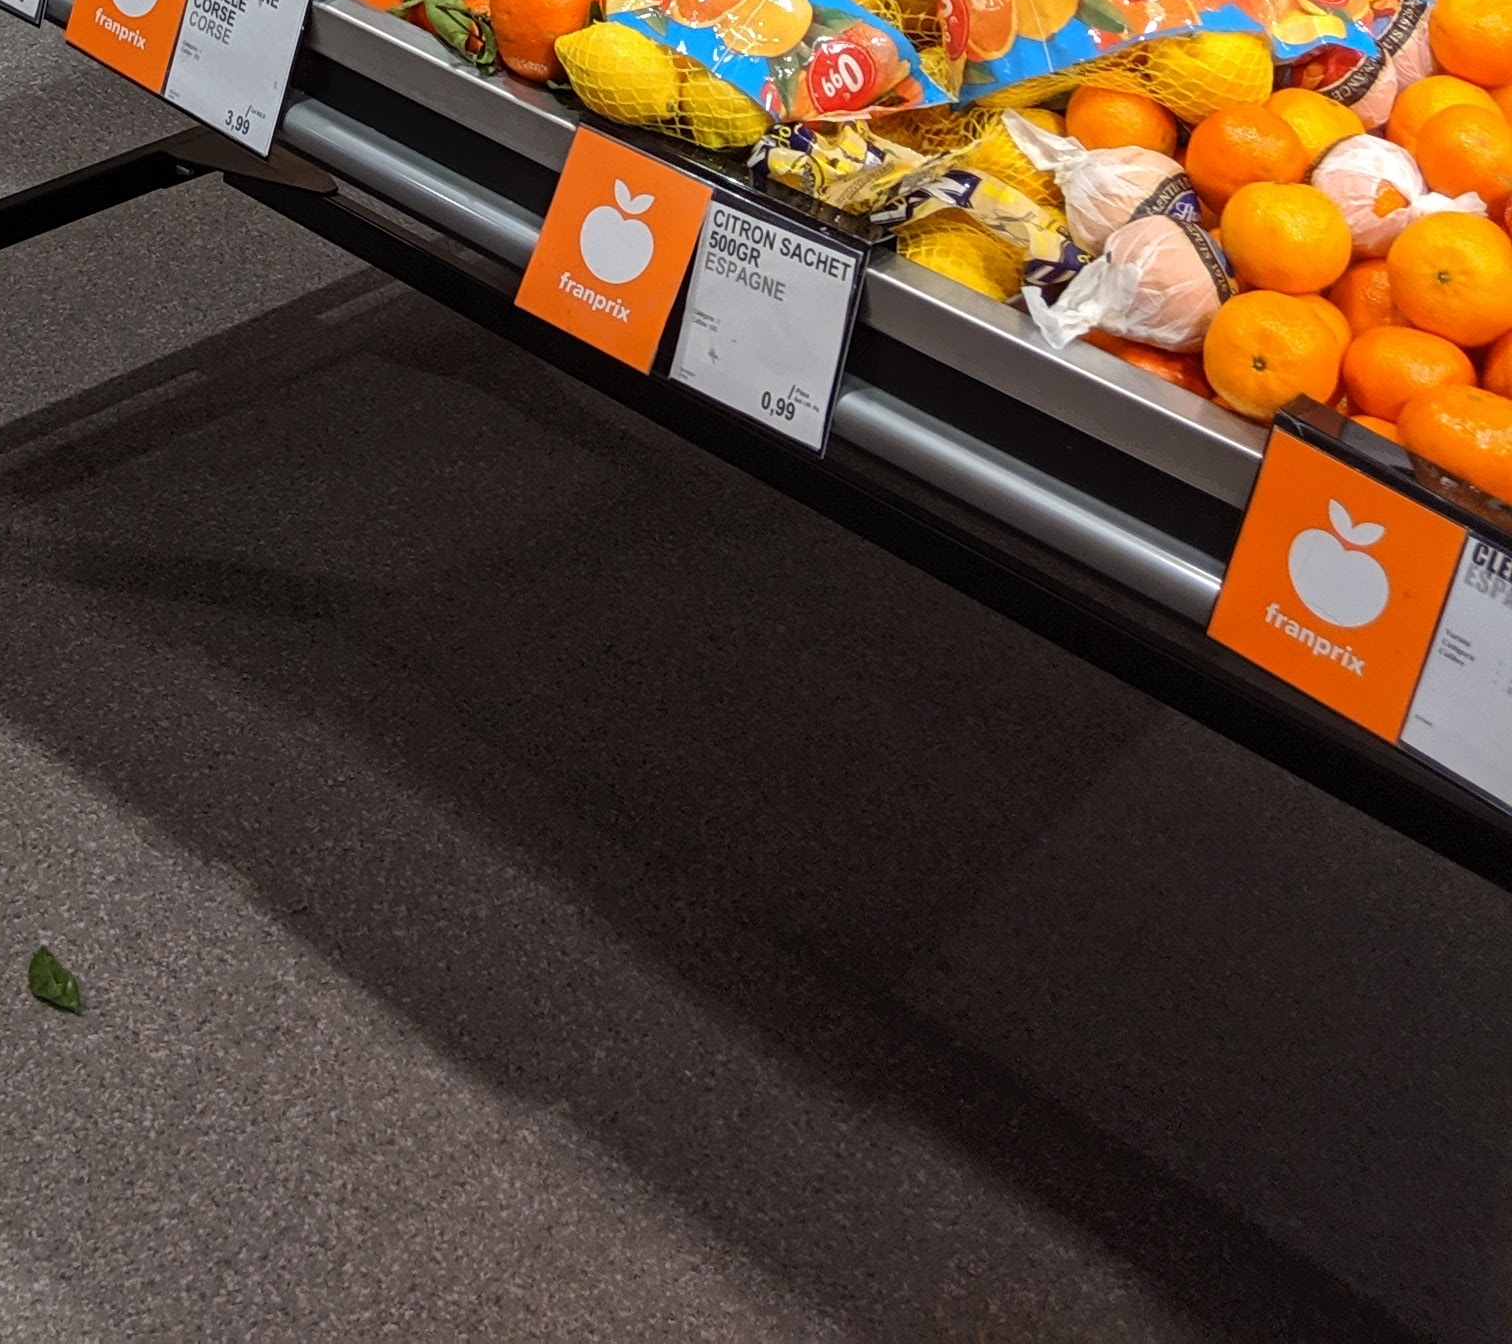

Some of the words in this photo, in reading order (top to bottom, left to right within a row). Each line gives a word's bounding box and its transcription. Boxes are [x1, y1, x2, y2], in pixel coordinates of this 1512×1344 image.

[94, 7, 146, 50] franprix
[189, 10, 233, 45] CORSE
[224, 110, 251, 136] 3,99
[708, 230, 762, 268] 500GR
[713, 208, 777, 251] CITRON
[779, 237, 852, 283] SACHET
[557, 272, 631, 323] franprix
[704, 252, 787, 302] ESPAGNE
[761, 391, 796, 421] 0,99
[1264, 603, 1366, 677] franprix
